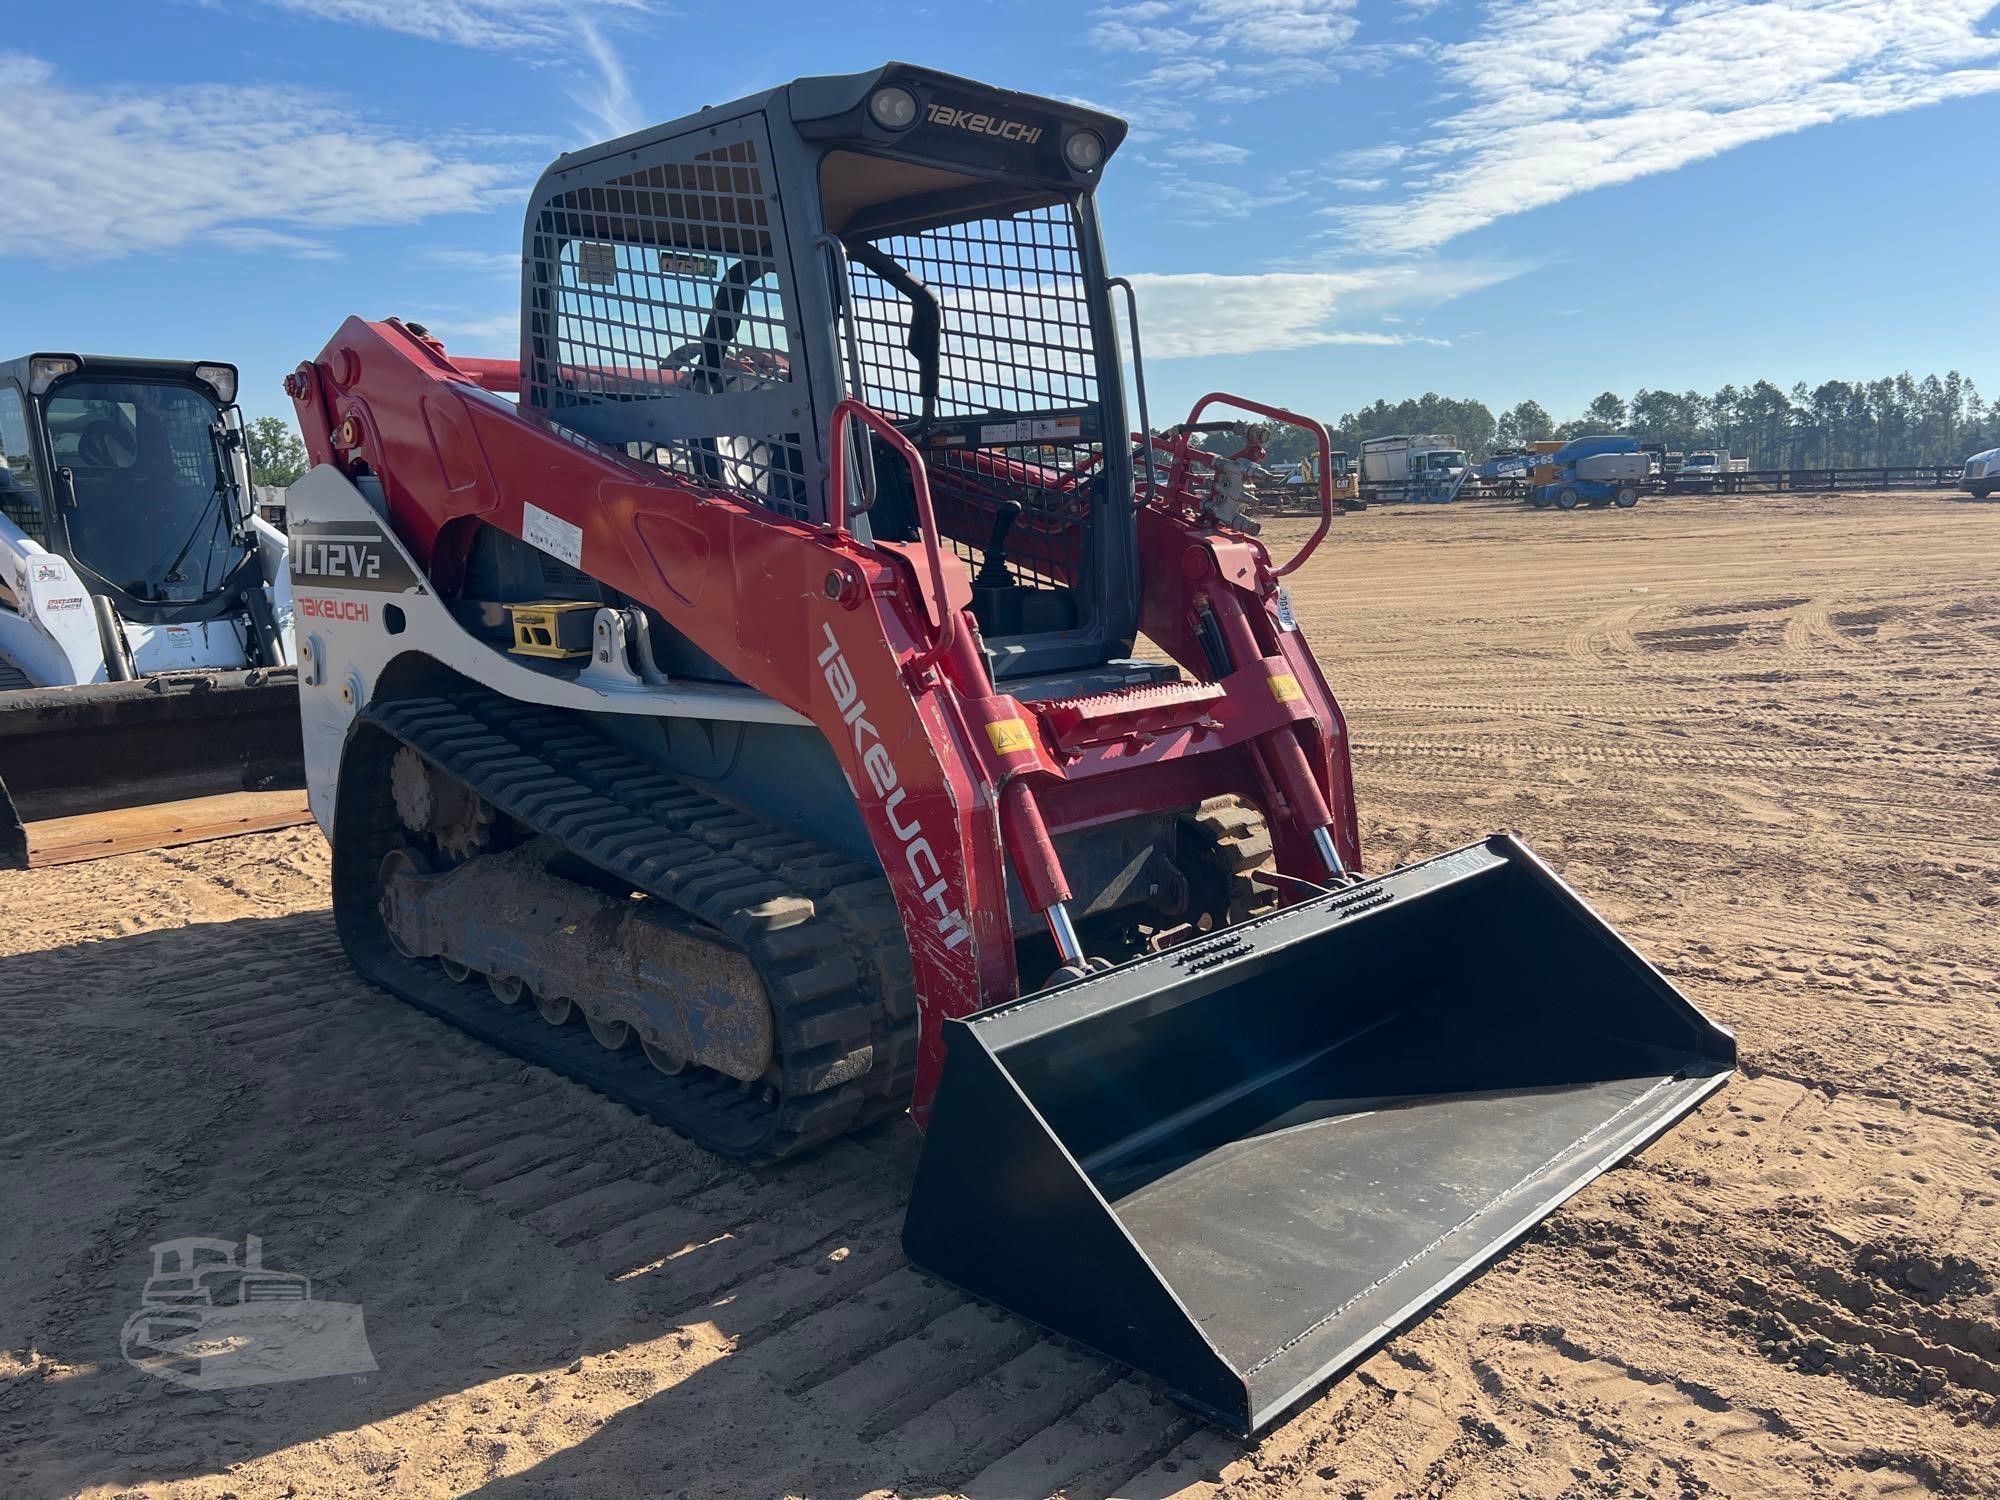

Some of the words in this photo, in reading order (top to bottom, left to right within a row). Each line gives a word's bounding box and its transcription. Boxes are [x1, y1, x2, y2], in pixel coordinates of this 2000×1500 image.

[927, 104, 1043, 145] TAKEUCHI
[1336, 479, 1349, 489] CAT
[1497, 461, 1524, 472] Genie
[290, 534, 382, 579] TL12V2
[817, 621, 970, 951] TAKEUCHI
